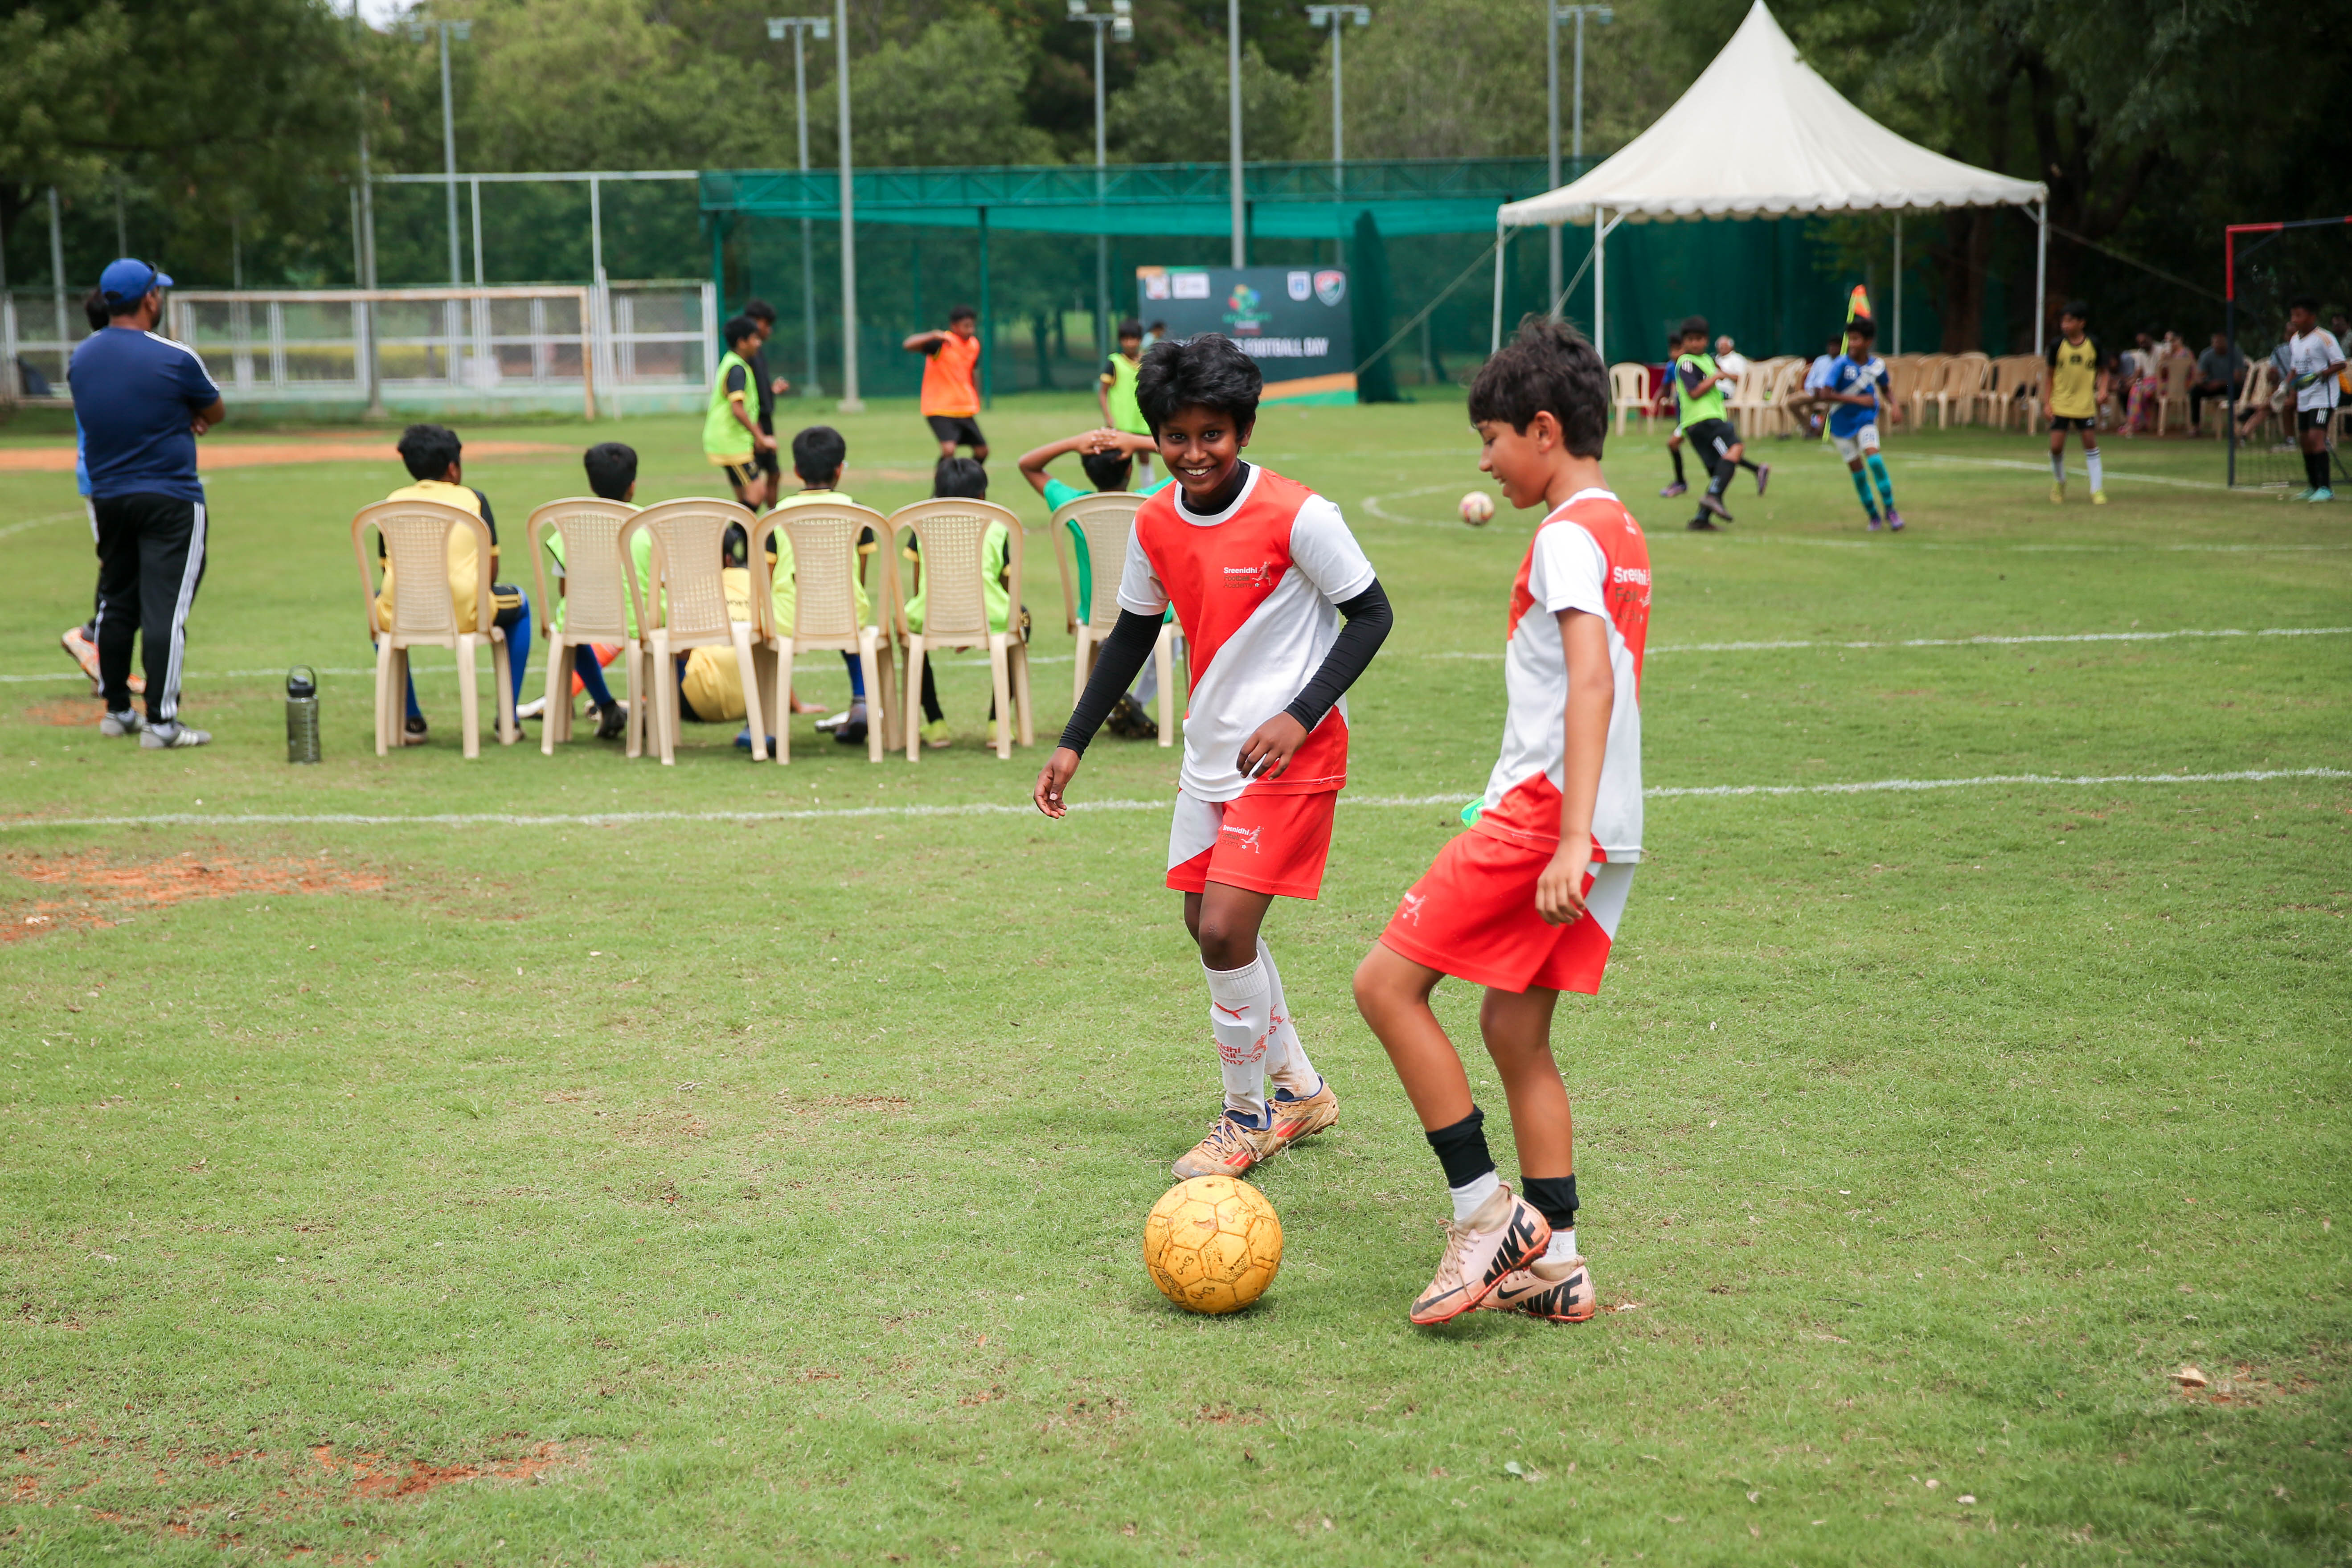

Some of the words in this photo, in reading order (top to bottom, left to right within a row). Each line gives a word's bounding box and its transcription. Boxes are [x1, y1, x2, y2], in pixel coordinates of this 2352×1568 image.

[1303, 337, 1329, 356] DAY
[1223, 824, 1250, 835] Sreenidhi
[1483, 1202, 1544, 1287] NIKE
[1516, 1273, 1582, 1317] NIKE
